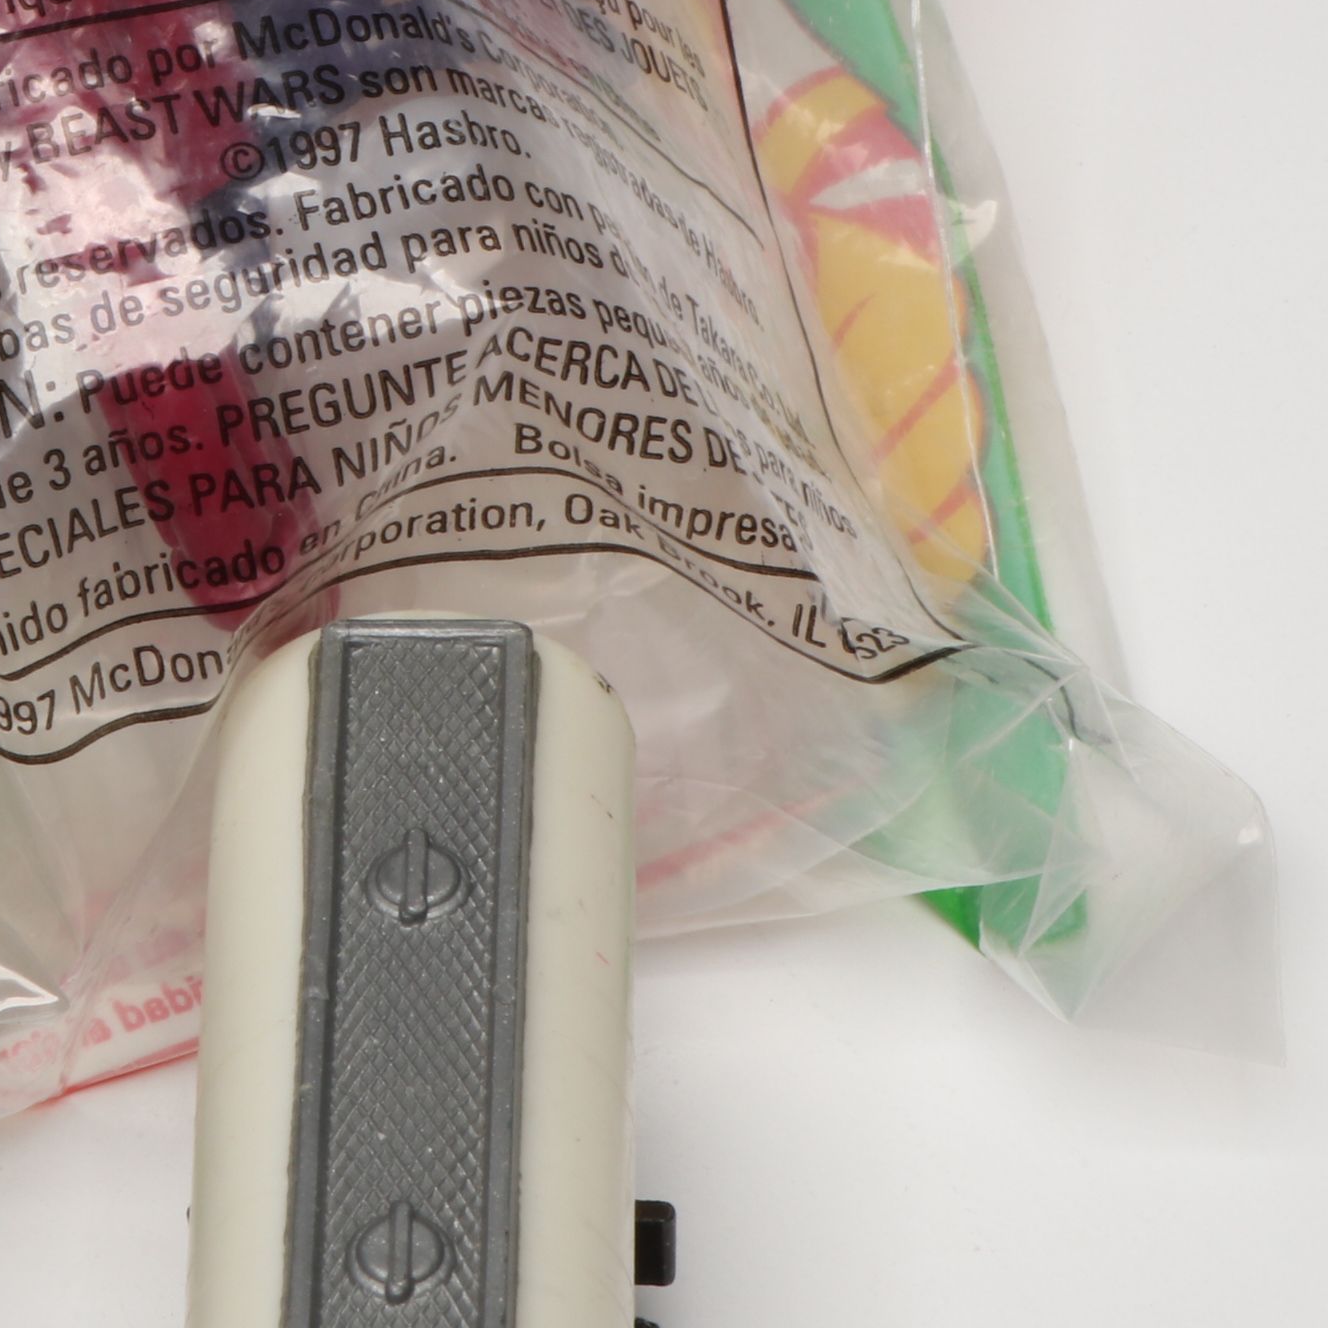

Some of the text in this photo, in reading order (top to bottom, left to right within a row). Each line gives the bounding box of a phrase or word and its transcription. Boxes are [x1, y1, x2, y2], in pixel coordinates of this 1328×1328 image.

[27, 94, 181, 164] BEAST
[194, 65, 345, 127] WARS
[361, 68, 437, 99] son
[147, 39, 217, 89] por
[233, 6, 475, 61] McDonald's
[220, 109, 531, 181] ©1997 Hasbro.
[18, 208, 283, 296] reservados.
[293, 163, 514, 231] Fabricado
[524, 180, 584, 222] con
[90, 282, 144, 335] de
[162, 225, 387, 317] seguridad
[401, 223, 501, 272] para
[512, 218, 603, 267] niños
[43, 449, 72, 490] 3
[82, 424, 204, 478] años.
[217, 348, 468, 447] PREGUNTE
[476, 326, 650, 391] ACERCA
[75, 351, 223, 416] Puede
[238, 298, 440, 378] contener
[457, 280, 586, 337] piezas
[189, 456, 321, 517] PARA
[473, 371, 694, 465] MENORES
[76, 538, 285, 619] fabricado
[299, 519, 341, 556] en
[513, 426, 624, 494] Bolsa
[636, 483, 799, 553] impresa
[564, 493, 643, 541] Oak
[791, 602, 827, 648] IL
